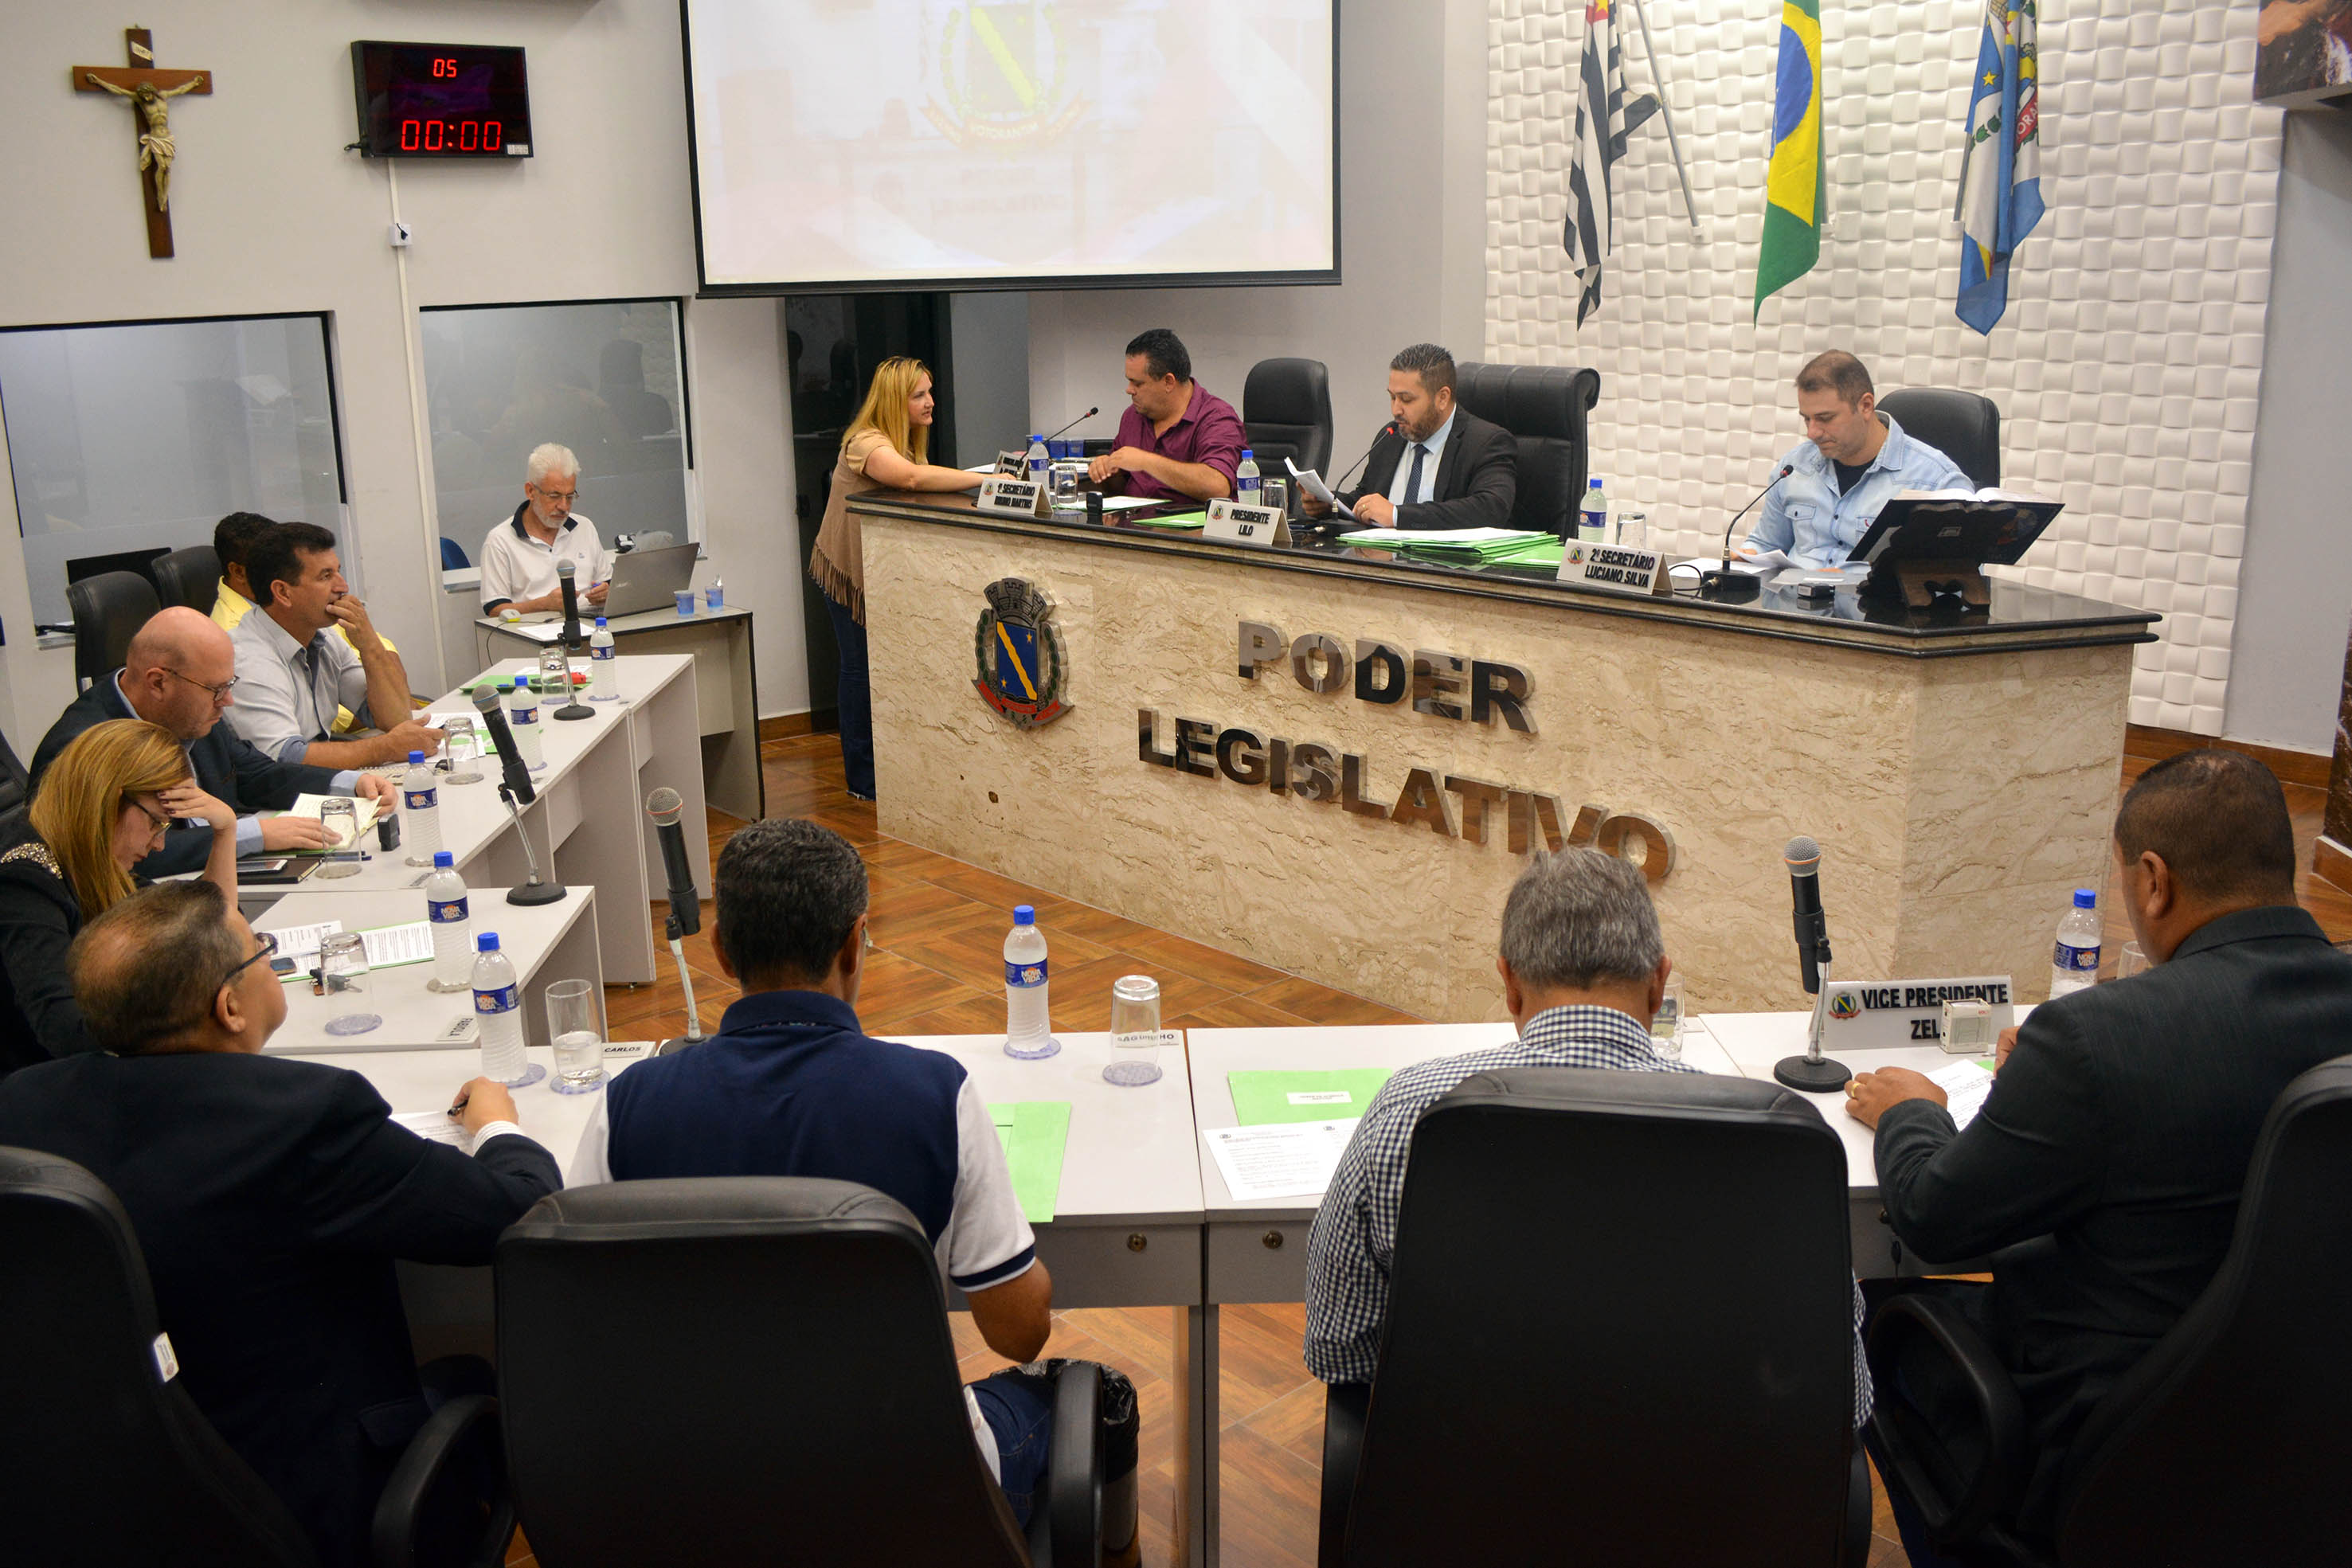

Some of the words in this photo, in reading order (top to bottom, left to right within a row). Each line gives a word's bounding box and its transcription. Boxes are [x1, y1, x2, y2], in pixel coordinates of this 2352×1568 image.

[432, 58, 457, 78] 05
[401, 119, 502, 151] 00:00
[1230, 509, 1270, 524] PRESIDENTE
[1238, 524, 1254, 537] LILO
[1590, 548, 1600, 562] 2º
[1599, 549, 1655, 570] SECRETÁRIO
[1584, 565, 1624, 583] LUCIANO
[1624, 570, 1650, 588] SILVA
[1238, 620, 1537, 734] PODER
[1137, 707, 1677, 882] LEGISLATIVO
[1861, 988, 1900, 1009] VICE
[1905, 983, 2009, 1007] PRESIDENTE
